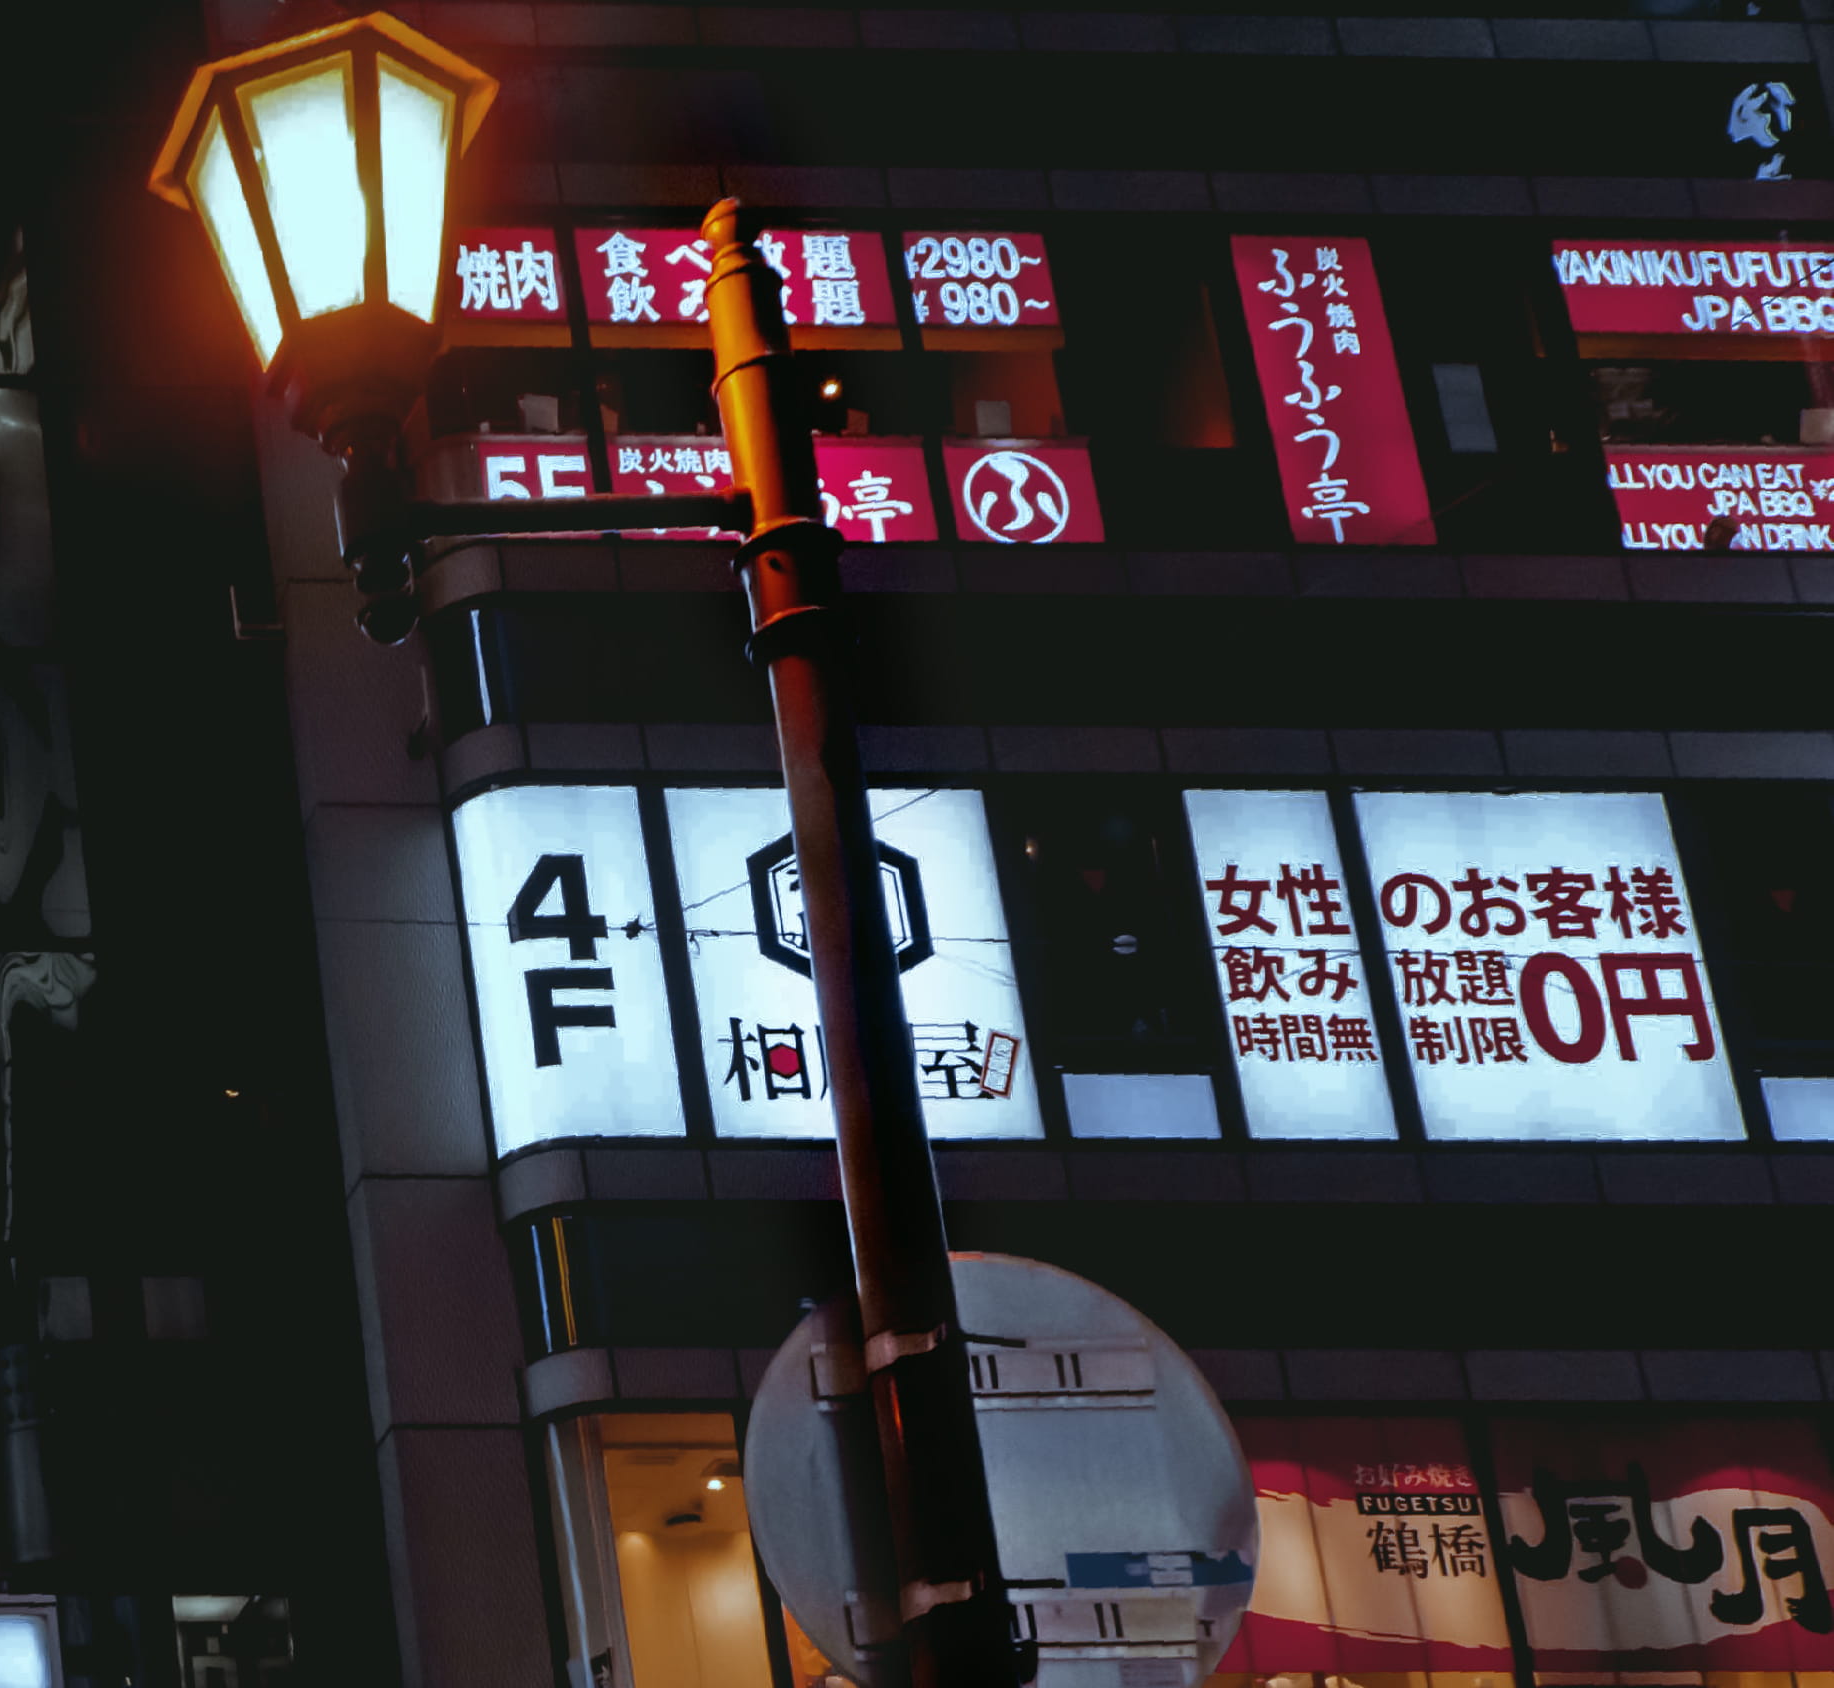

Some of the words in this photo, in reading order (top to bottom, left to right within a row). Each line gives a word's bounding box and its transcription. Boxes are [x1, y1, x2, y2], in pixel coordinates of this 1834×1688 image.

[457, 243, 558, 311] 焼肉
[607, 276, 866, 325] 飲み題
[1316, 247, 1360, 354] 炭火焼肉
[1258, 249, 1370, 543] ふうふう亭
[619, 446, 732, 474] 炭火焼肉
[1519, 951, 1716, 1064] 0円
[718, 1016, 997, 1101] 相屋
[1362, 1496, 1473, 1513] FUGETSU
[1365, 1521, 1487, 1580] 鶴橋
[1504, 1460, 1834, 1636] 風月
